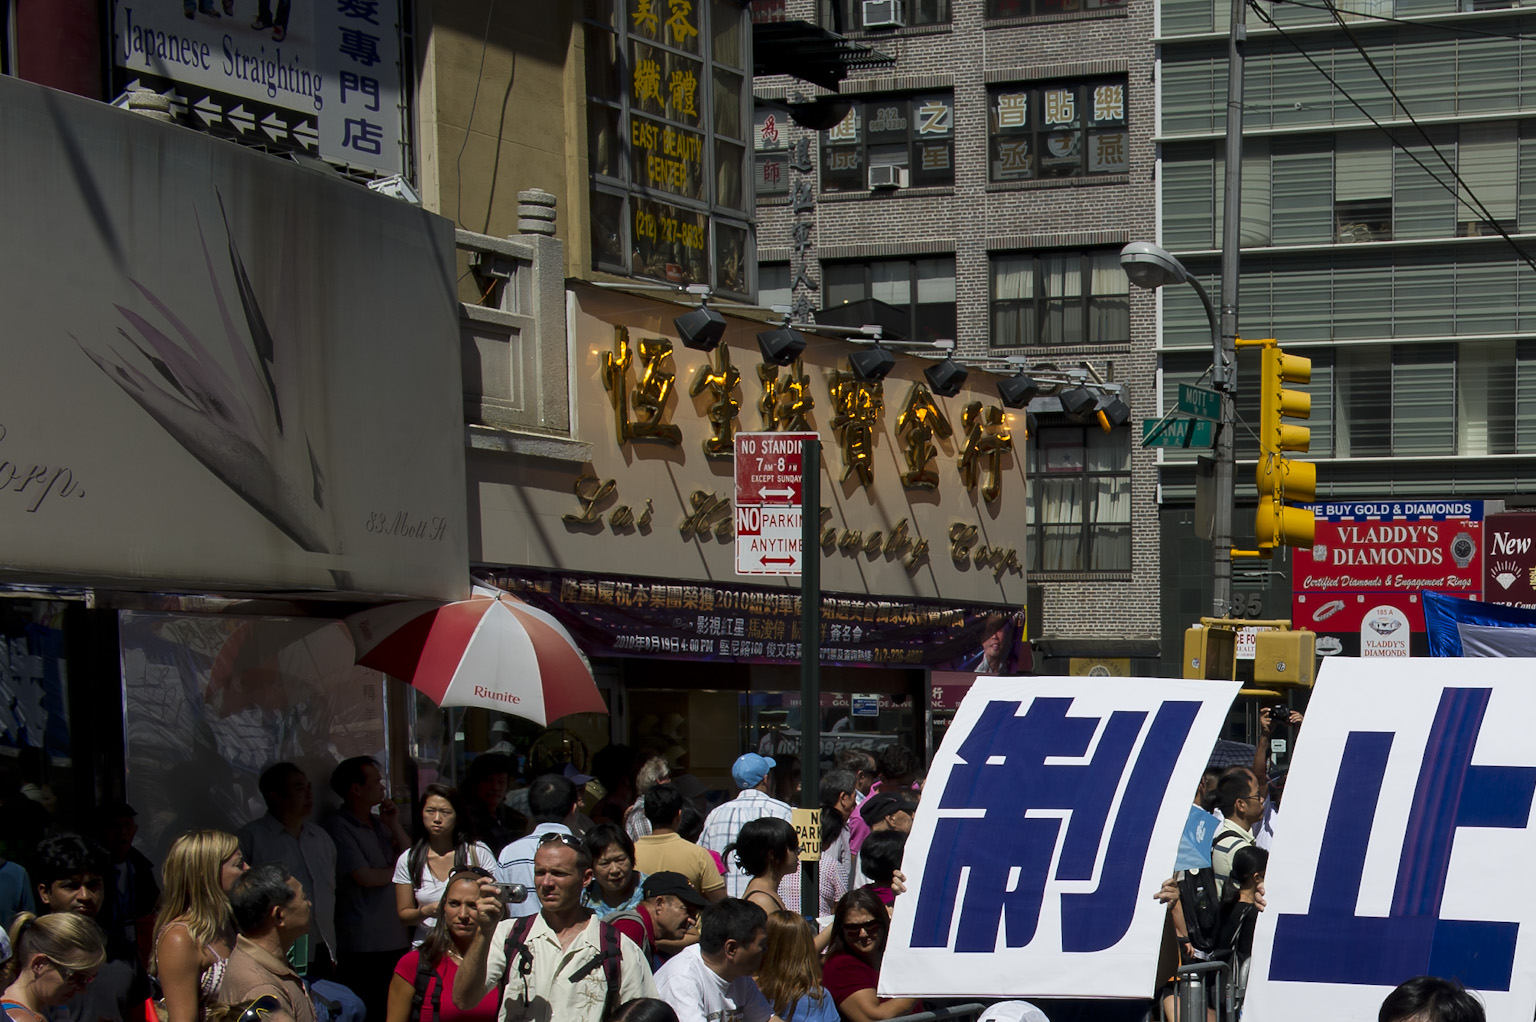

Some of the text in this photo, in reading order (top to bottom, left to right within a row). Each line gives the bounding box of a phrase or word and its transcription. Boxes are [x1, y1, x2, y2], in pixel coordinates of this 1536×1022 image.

[124, 7, 323, 111] Japanese Straighting
[633, 59, 698, 118] 纖體
[876, 107, 900, 120] 212
[632, 121, 702, 164] EAST BEAUTY
[646, 155, 688, 188] CENTER
[635, 210, 657, 244] (212)
[1185, 387, 1207, 408] MOTT
[741, 439, 803, 455] NO STANDIN
[750, 475, 774, 483] EXCEPT
[1304, 503, 1473, 516] WE BUY GOLD & DIAMONDS
[561, 474, 653, 527] Lai
[948, 522, 1024, 582] Corp.
[737, 507, 760, 532] NO
[1337, 525, 1439, 544] VLADDY'S
[1490, 531, 1532, 556] New
[1332, 547, 1443, 566] DIAMONDS
[1303, 574, 1472, 590] Certified Diamonds & Engagement Rings
[1246, 634, 1256, 645] FO
[1365, 640, 1406, 648] VLADDY'S
[1364, 649, 1407, 657] DIAMONDS
[474, 685, 522, 704] Riunite
[832, 700, 850, 708] GOL
[931, 700, 946, 708] NC.
[911, 697, 1201, 954] 制
